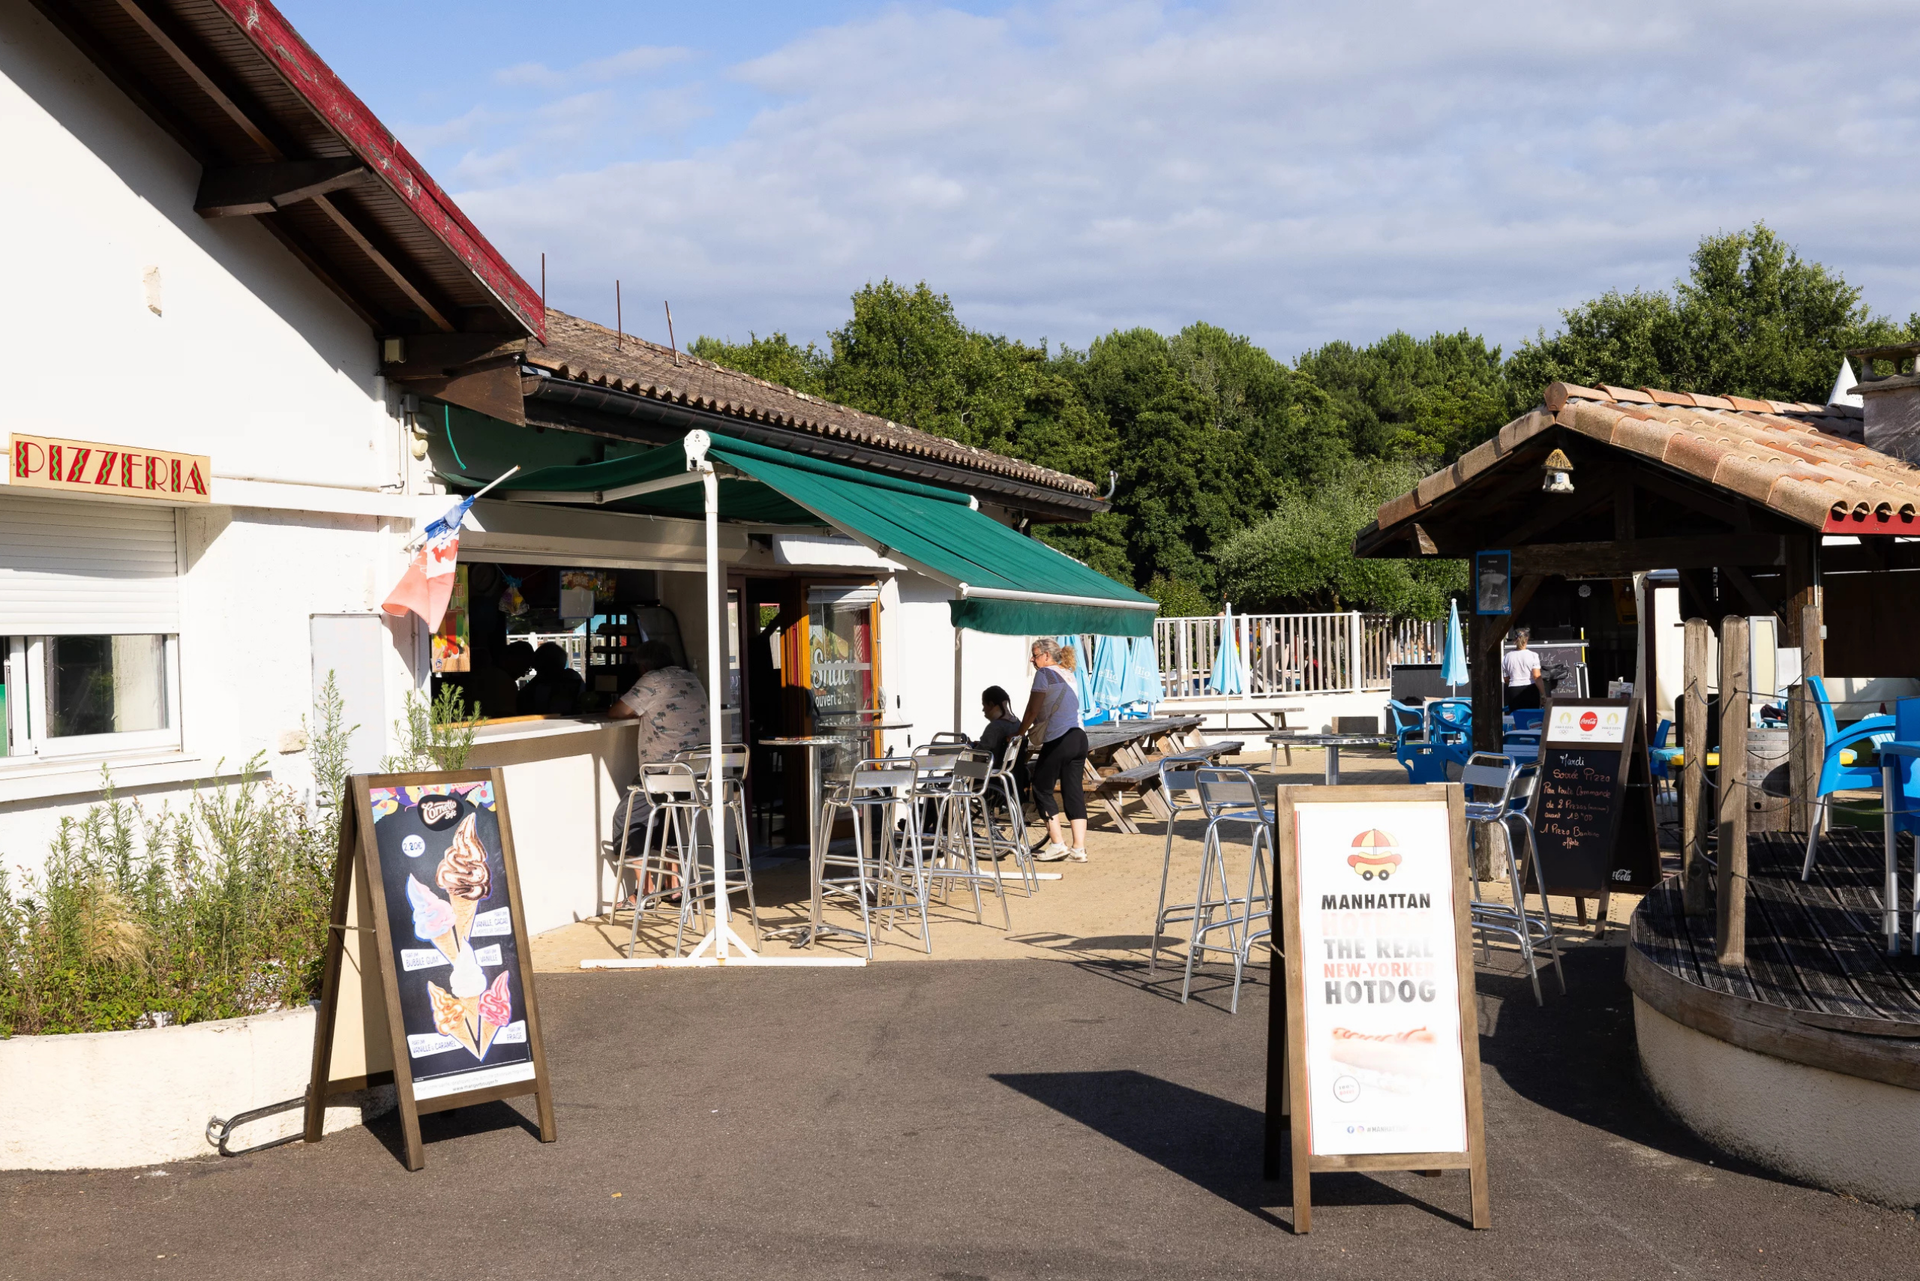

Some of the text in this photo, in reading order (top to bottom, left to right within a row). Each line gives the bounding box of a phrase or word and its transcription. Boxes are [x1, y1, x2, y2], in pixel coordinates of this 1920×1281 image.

[15, 440, 207, 495] PIZZERIA
[812, 648, 857, 689] Snack
[815, 692, 836, 707] ouvert
[1559, 753, 1584, 767] Mardi
[1583, 767, 1611, 782] Pizza
[1546, 800, 1554, 809] de
[1557, 799, 1563, 809] 2
[421, 799, 457, 825] Cornetto
[444, 809, 457, 820] Soft
[1539, 823, 1548, 833] 1
[1321, 893, 1431, 910] MANHATTAN
[1323, 938, 1434, 959] THE REAL
[406, 957, 424, 968] BUBBLE
[1323, 962, 1436, 978] NEW-YORKER
[1324, 979, 1437, 1004] HOTDOG
